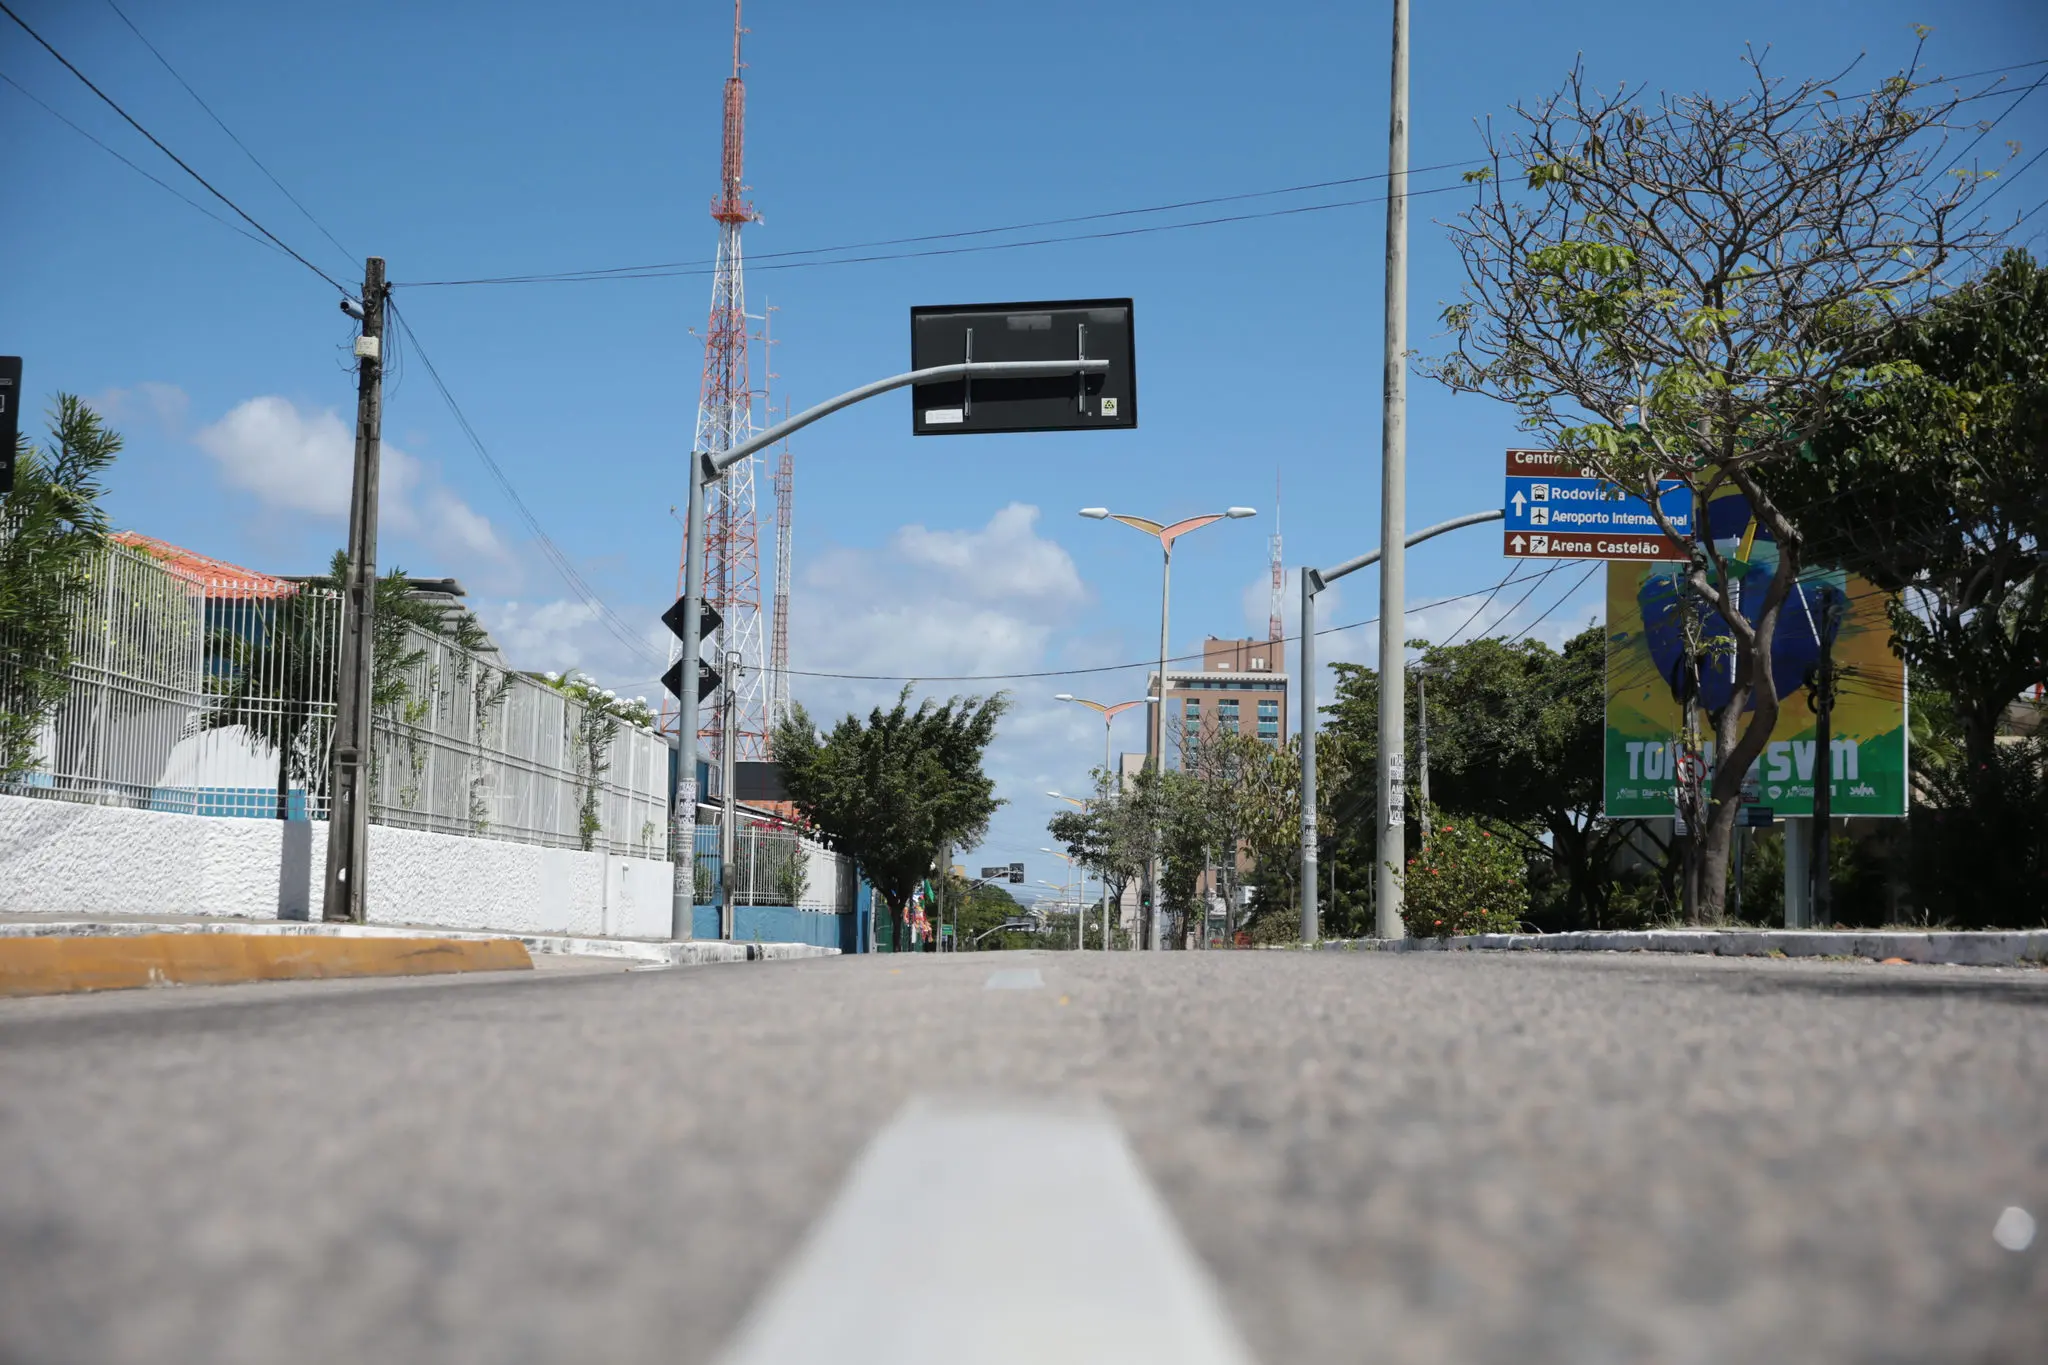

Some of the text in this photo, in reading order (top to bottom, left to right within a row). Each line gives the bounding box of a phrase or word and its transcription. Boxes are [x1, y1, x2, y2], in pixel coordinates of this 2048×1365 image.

[1551, 510, 1609, 526] Aeroporto
[1551, 539, 1660, 555] Arena Castelão
